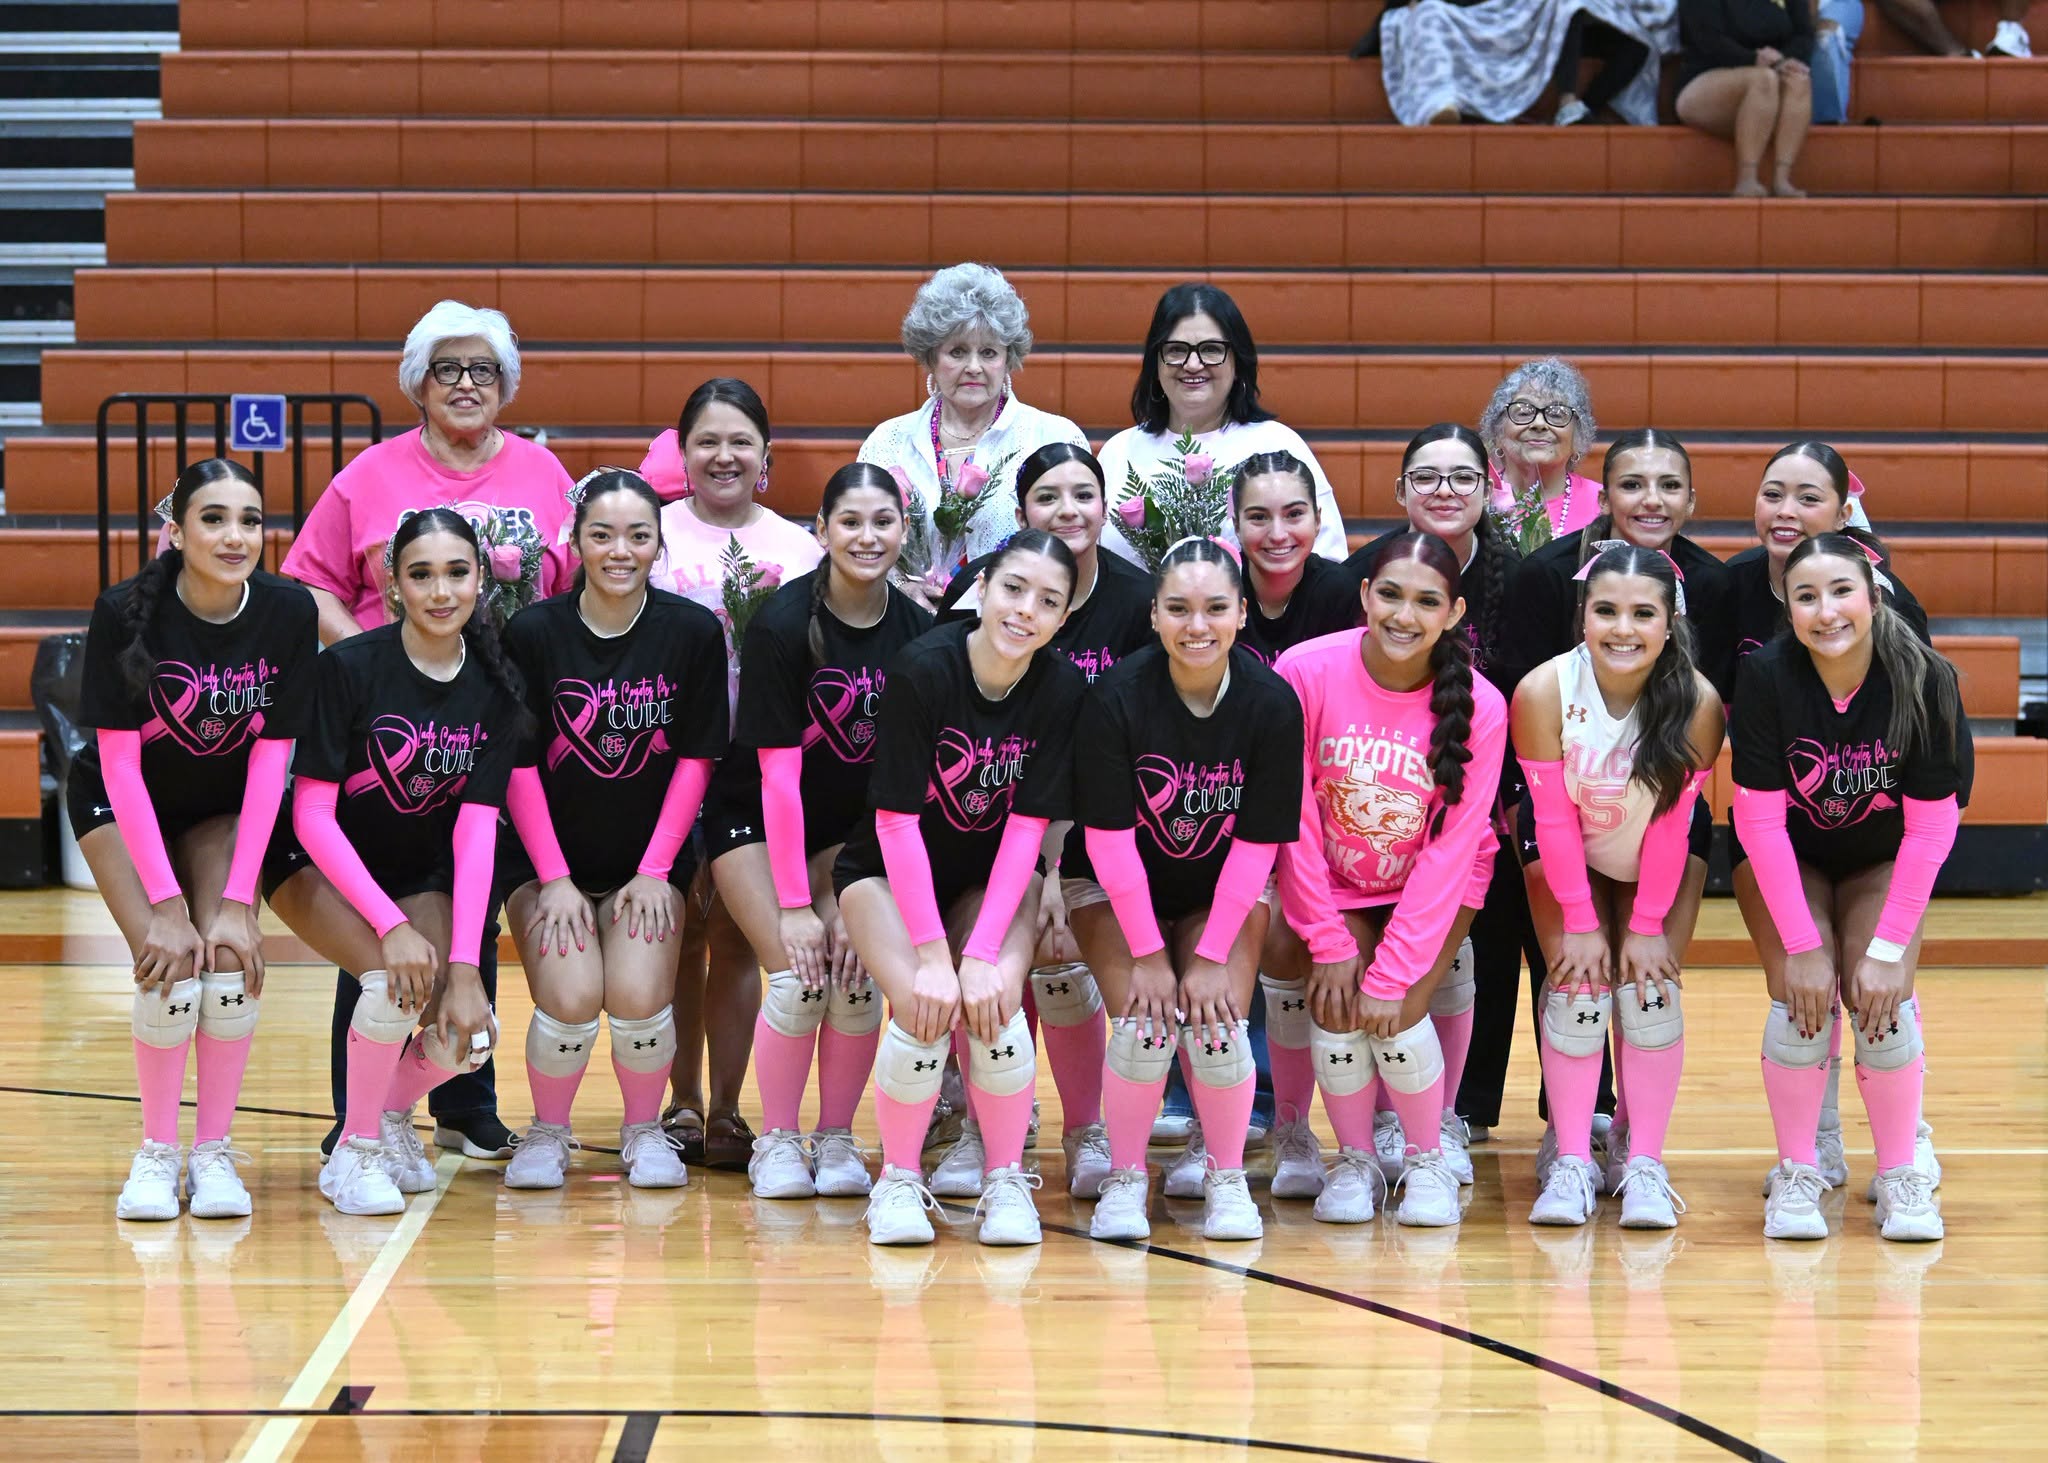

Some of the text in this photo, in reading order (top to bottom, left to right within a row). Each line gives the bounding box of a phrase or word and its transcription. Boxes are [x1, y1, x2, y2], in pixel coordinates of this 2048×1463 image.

[199, 663, 220, 695] Lady
[223, 662, 255, 695] Coyotes
[597, 678, 618, 707] Lady
[621, 677, 654, 710] Coyotes
[853, 666, 872, 696] Lady
[210, 681, 275, 715] CURE
[608, 697, 674, 729] CURE
[417, 720, 437, 750] Lady
[440, 724, 471, 756] Coyotes
[1346, 723, 1418, 747] ALICE
[1564, 741, 1637, 780] ALIC
[1842, 741, 1872, 775] Coyotes
[1874, 738, 1889, 765] for
[1198, 762, 1230, 795] Coyotes
[1833, 764, 1898, 795] CURE
[1577, 782, 1627, 832] 5
